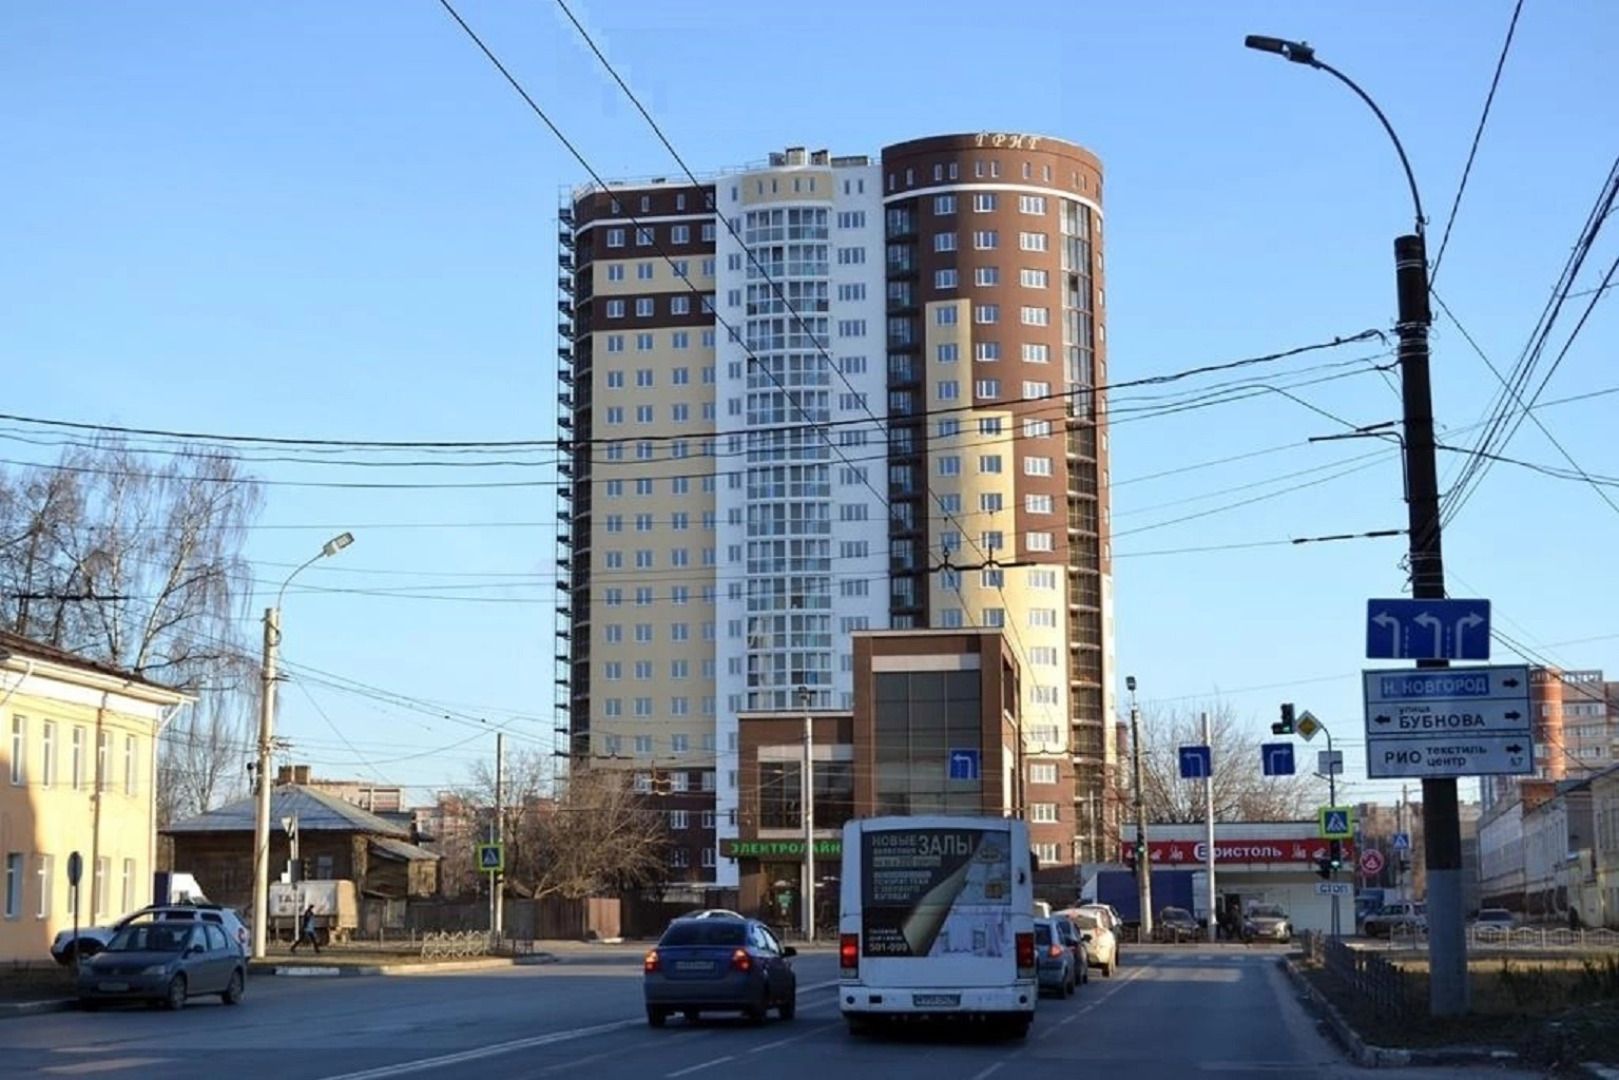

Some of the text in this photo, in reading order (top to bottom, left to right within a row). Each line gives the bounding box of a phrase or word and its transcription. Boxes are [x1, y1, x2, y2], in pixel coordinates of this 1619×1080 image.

[1402, 677, 1487, 694] НОВГОРОД
[1398, 706, 1431, 715] улица
[1399, 714, 1486, 729] БУБНОВА
[1384, 745, 1487, 764] РИО текстиль
[1427, 757, 1466, 767] центр
[871, 835, 918, 847] НОВЫЕ
[918, 834, 973, 855] ЗАЛЫ
[1319, 883, 1349, 893] СТОП
